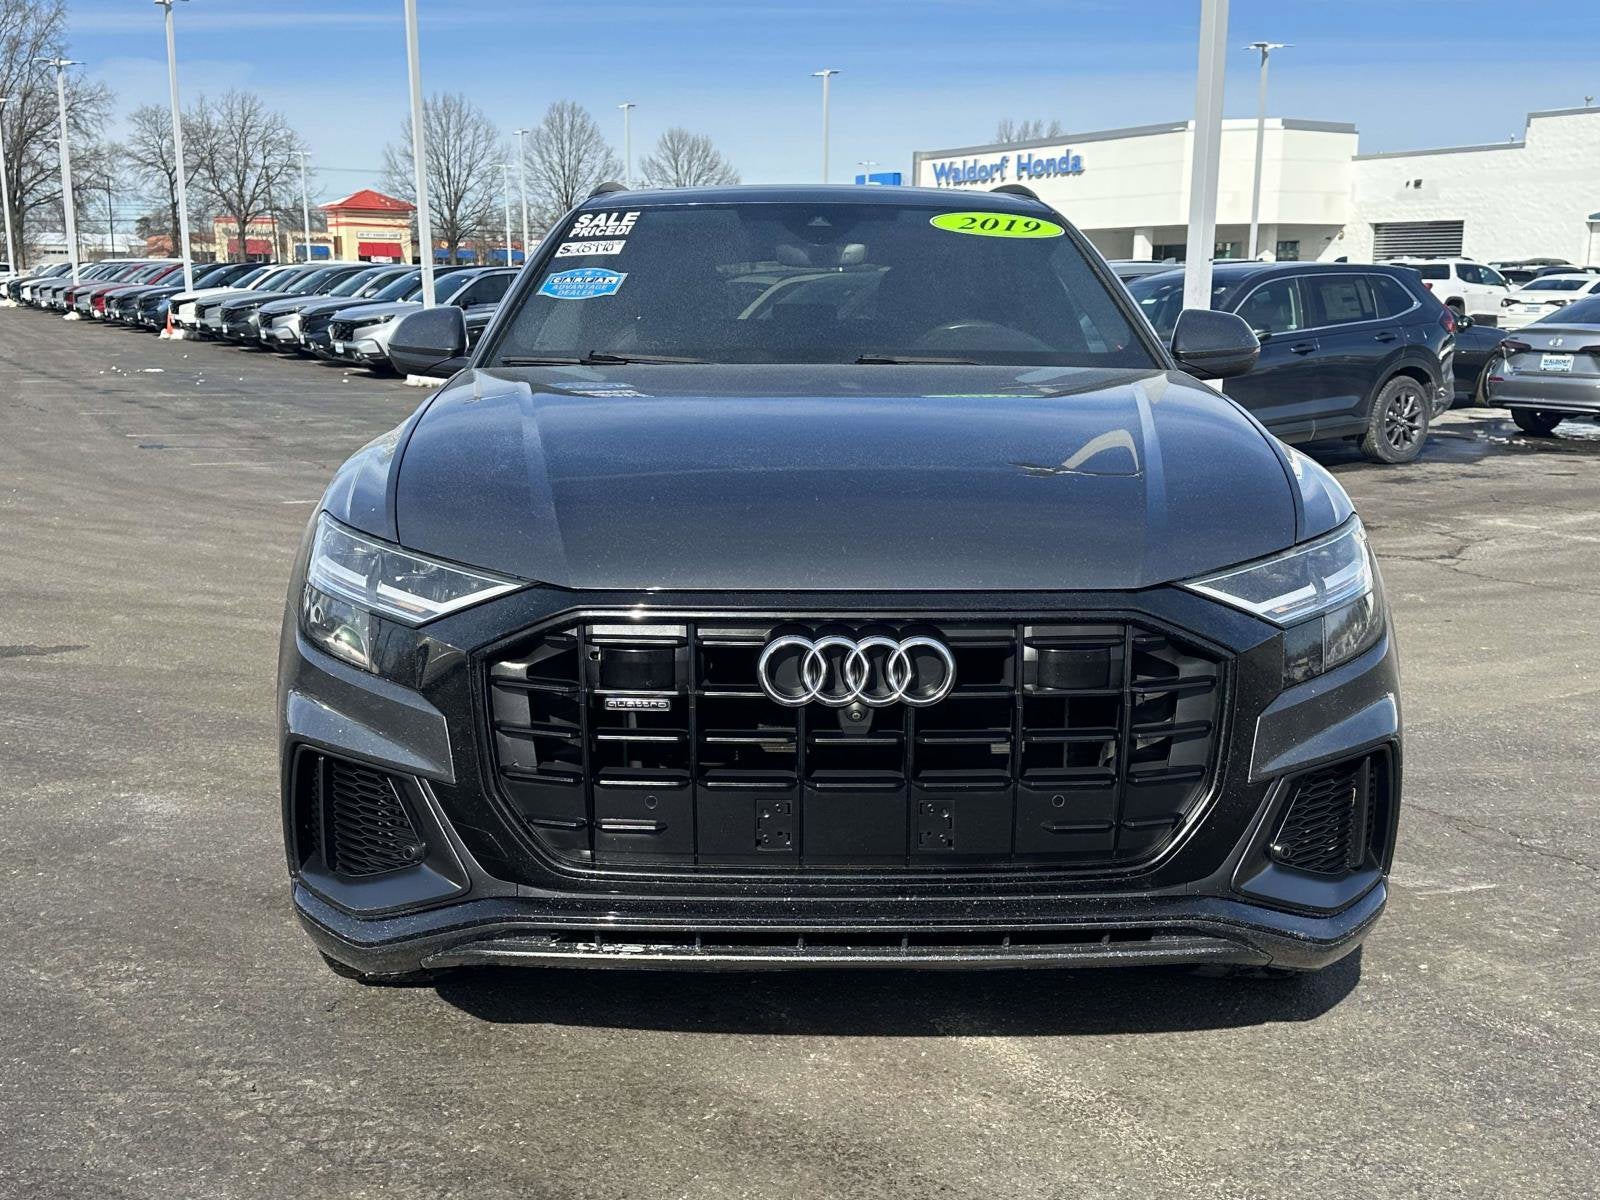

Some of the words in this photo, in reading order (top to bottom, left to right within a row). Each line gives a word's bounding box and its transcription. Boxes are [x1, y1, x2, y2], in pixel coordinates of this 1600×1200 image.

[932, 155, 1010, 185] Waldorf
[1016, 149, 1084, 179] Honda
[574, 212, 641, 228] SALE
[958, 216, 1041, 232] 2019
[569, 225, 632, 237] PRICED!
